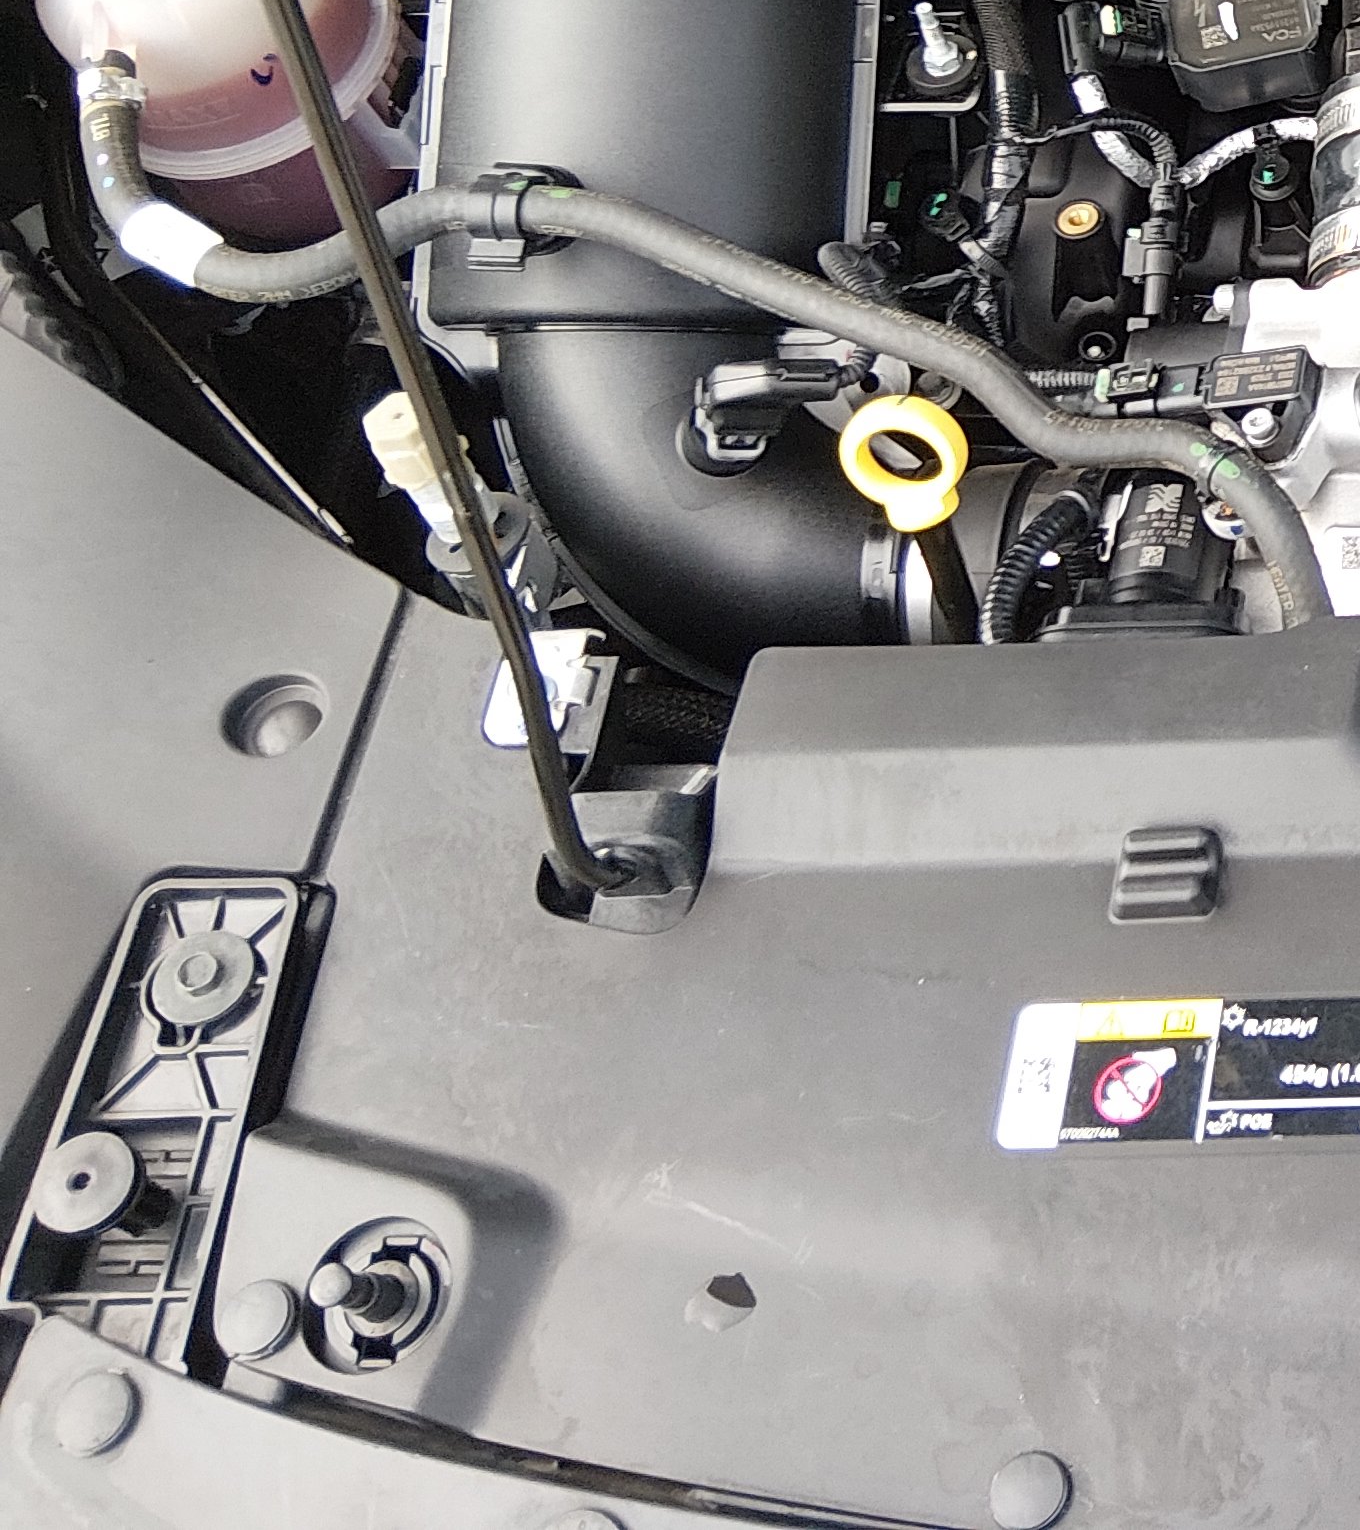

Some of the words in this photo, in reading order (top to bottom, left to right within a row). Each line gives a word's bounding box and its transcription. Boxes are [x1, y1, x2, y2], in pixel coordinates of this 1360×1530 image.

[1261, 26, 1304, 44] FCA
[1278, 1062, 1329, 1089] 454g
[1239, 1113, 1274, 1131] POE
